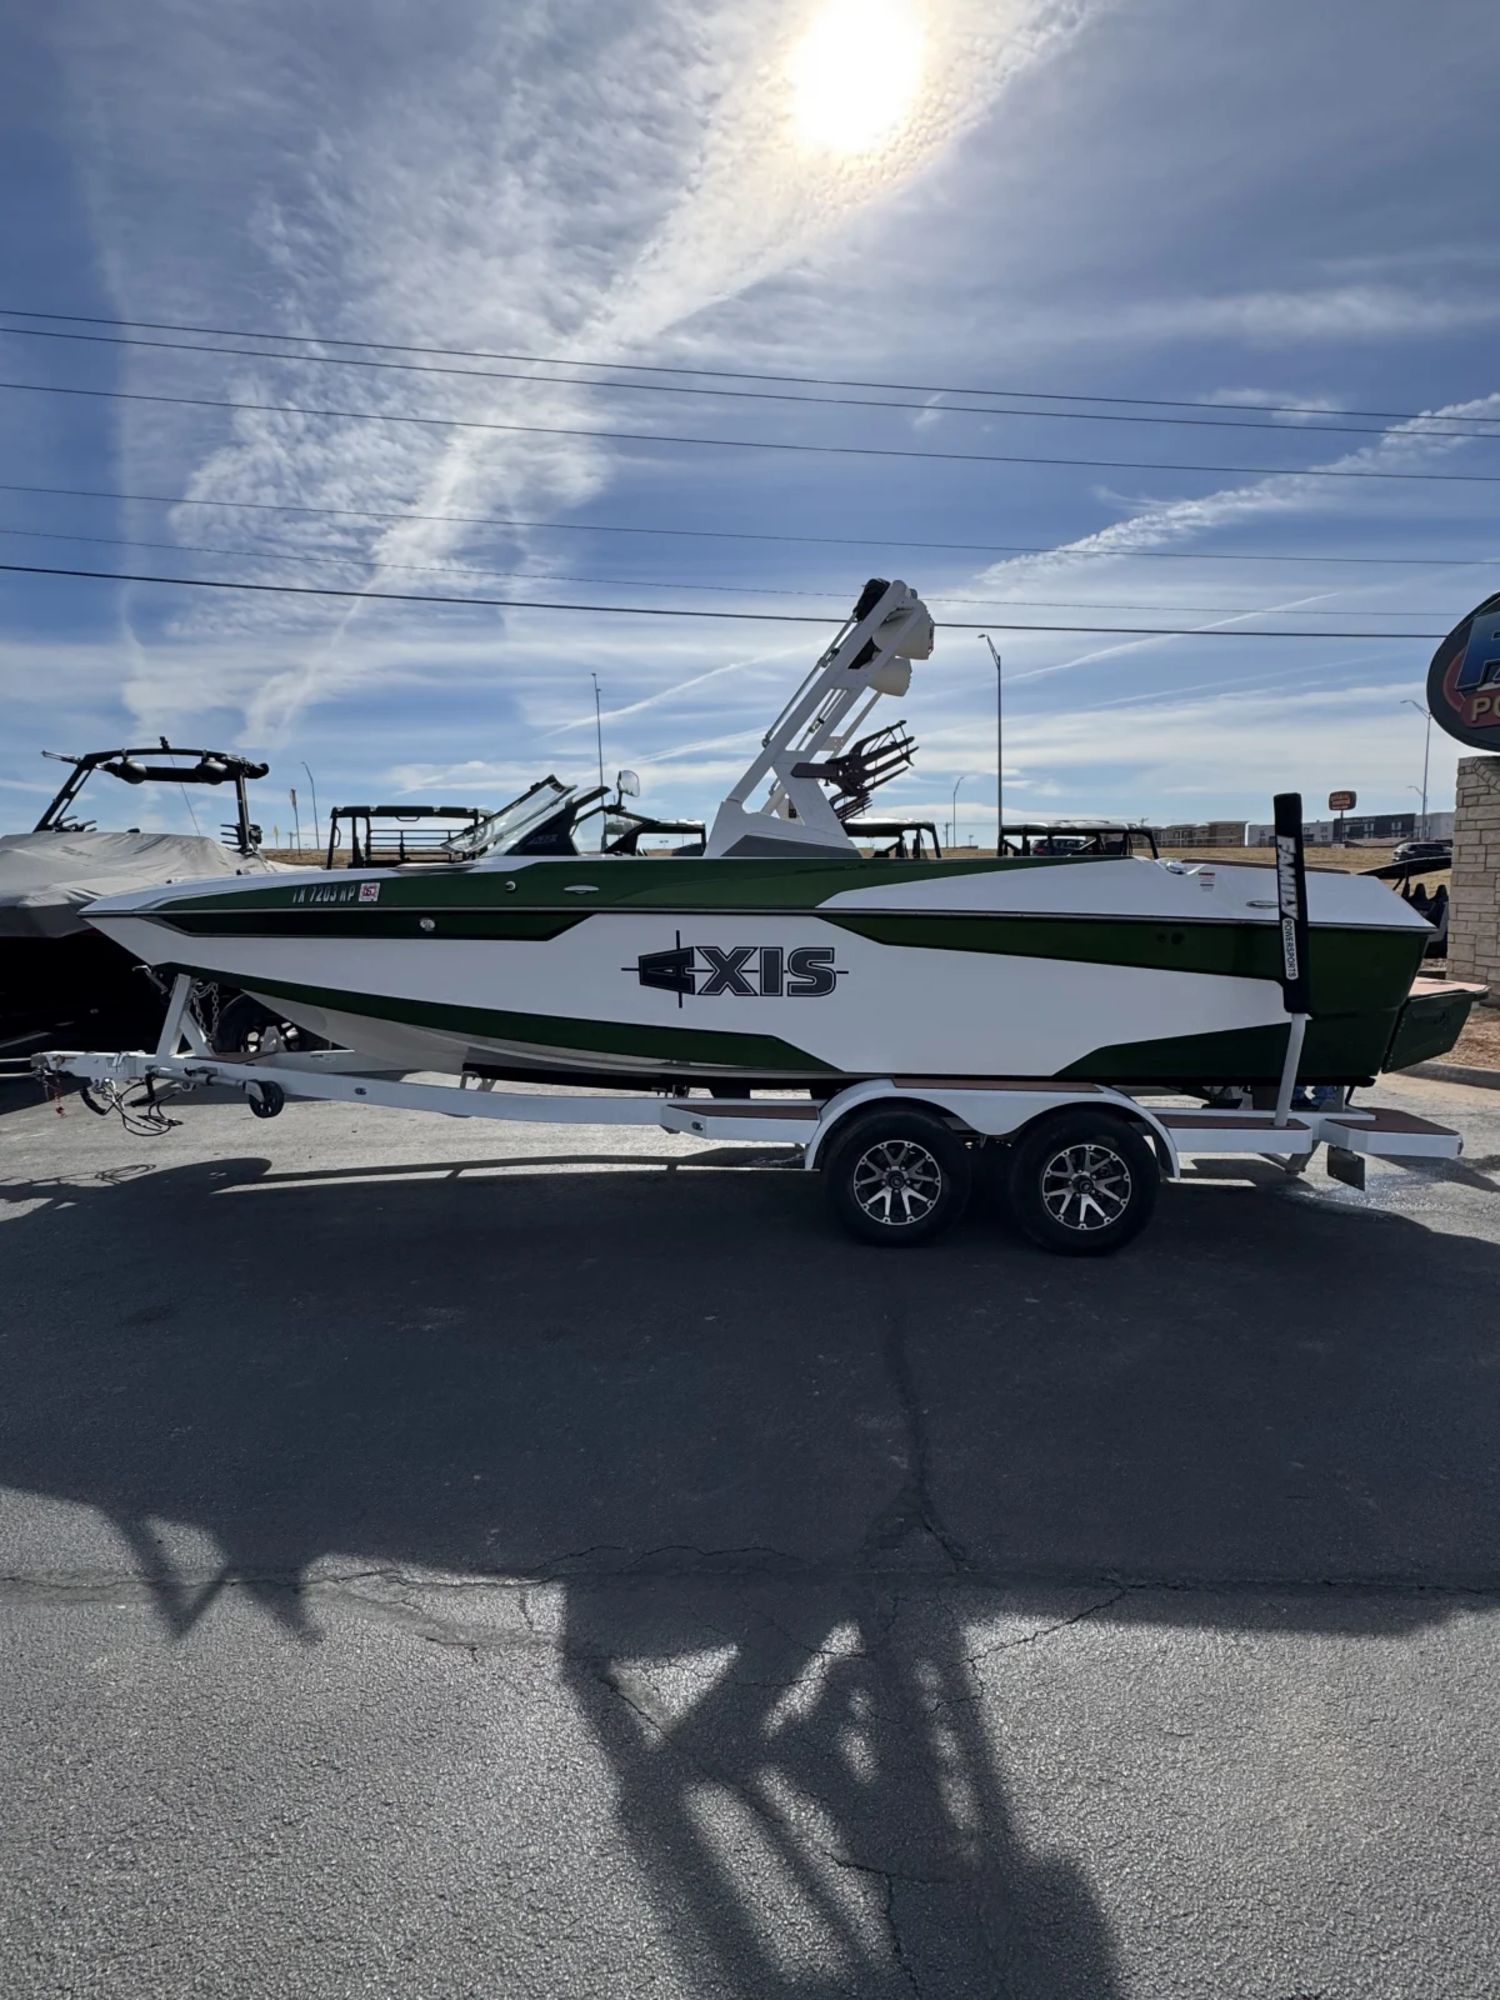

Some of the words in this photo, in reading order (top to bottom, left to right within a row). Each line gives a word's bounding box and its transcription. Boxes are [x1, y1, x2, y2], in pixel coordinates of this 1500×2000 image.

[1277, 834, 1299, 920] FAMILY
[638, 946, 837, 997] AXIS
[1284, 920, 1297, 978] POWERSPORTS
